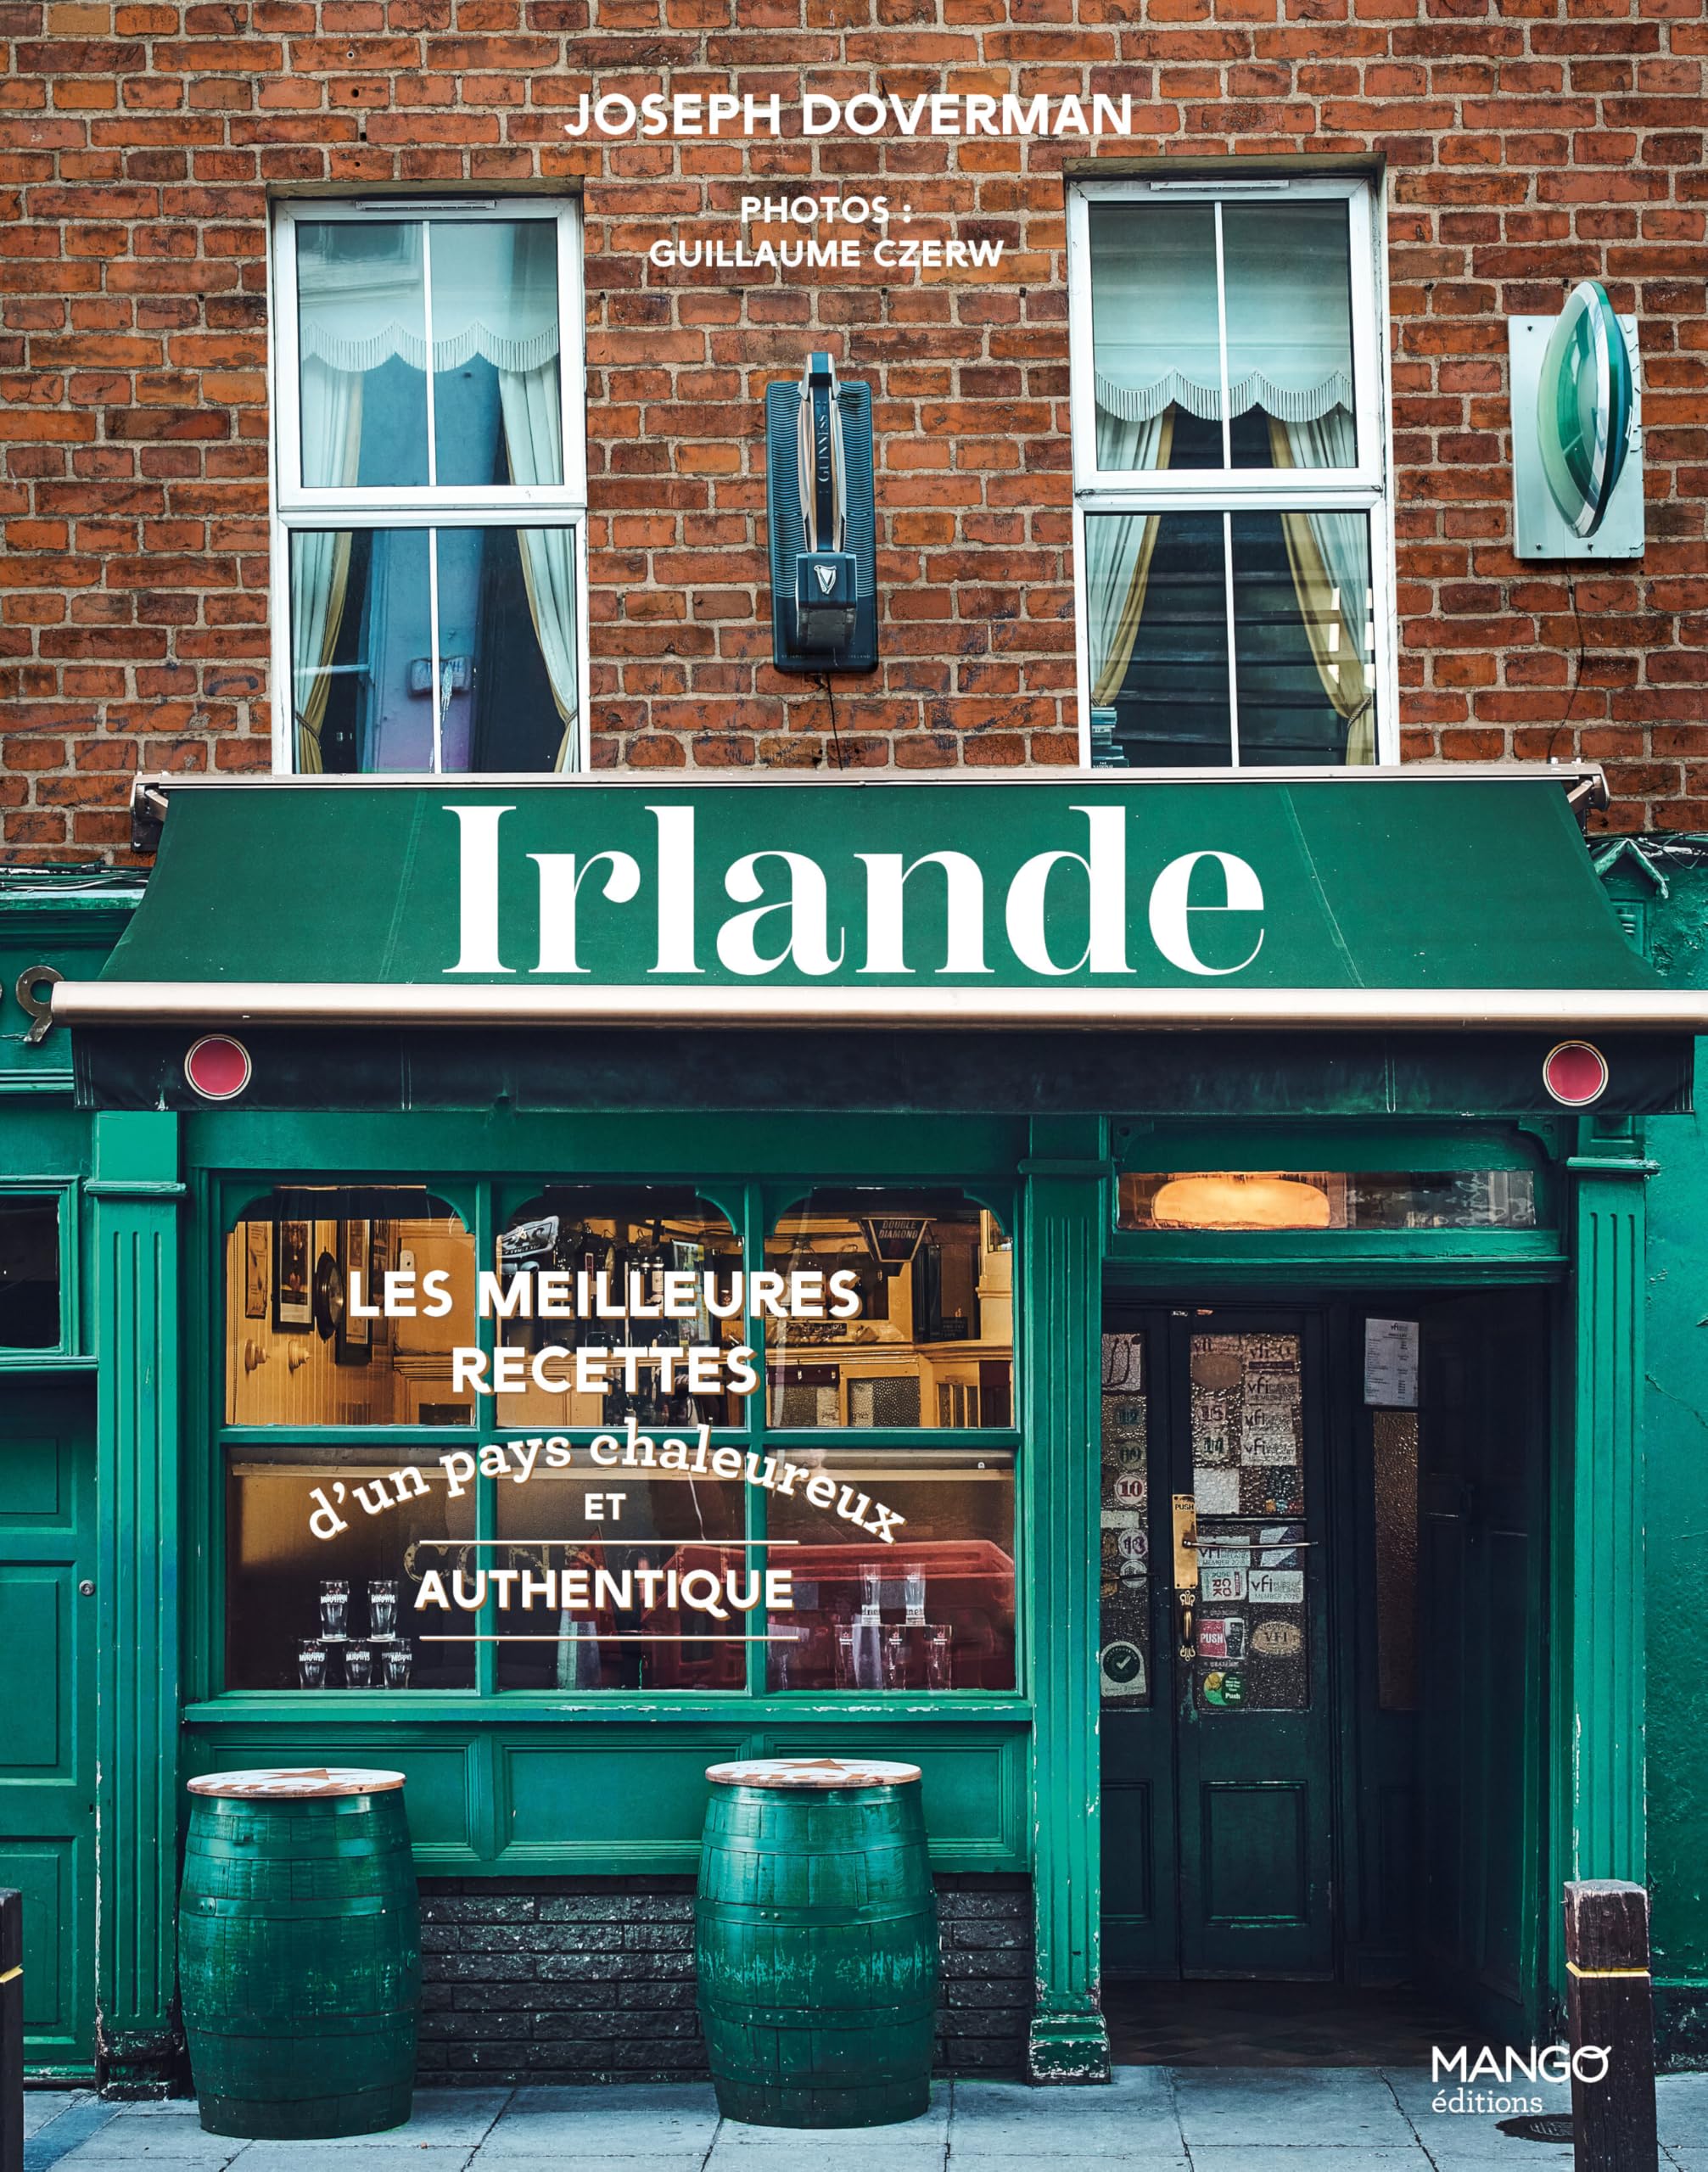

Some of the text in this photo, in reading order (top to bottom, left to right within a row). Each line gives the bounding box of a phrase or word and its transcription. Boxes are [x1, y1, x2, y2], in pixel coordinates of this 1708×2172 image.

[882, 1220, 916, 1229] DOUBLE
[878, 1229, 919, 1240] DIAMOND
[1119, 1481, 1143, 1497] 10
[1251, 1574, 1273, 1593] vfi
[1200, 1632, 1224, 1644] PUSH
